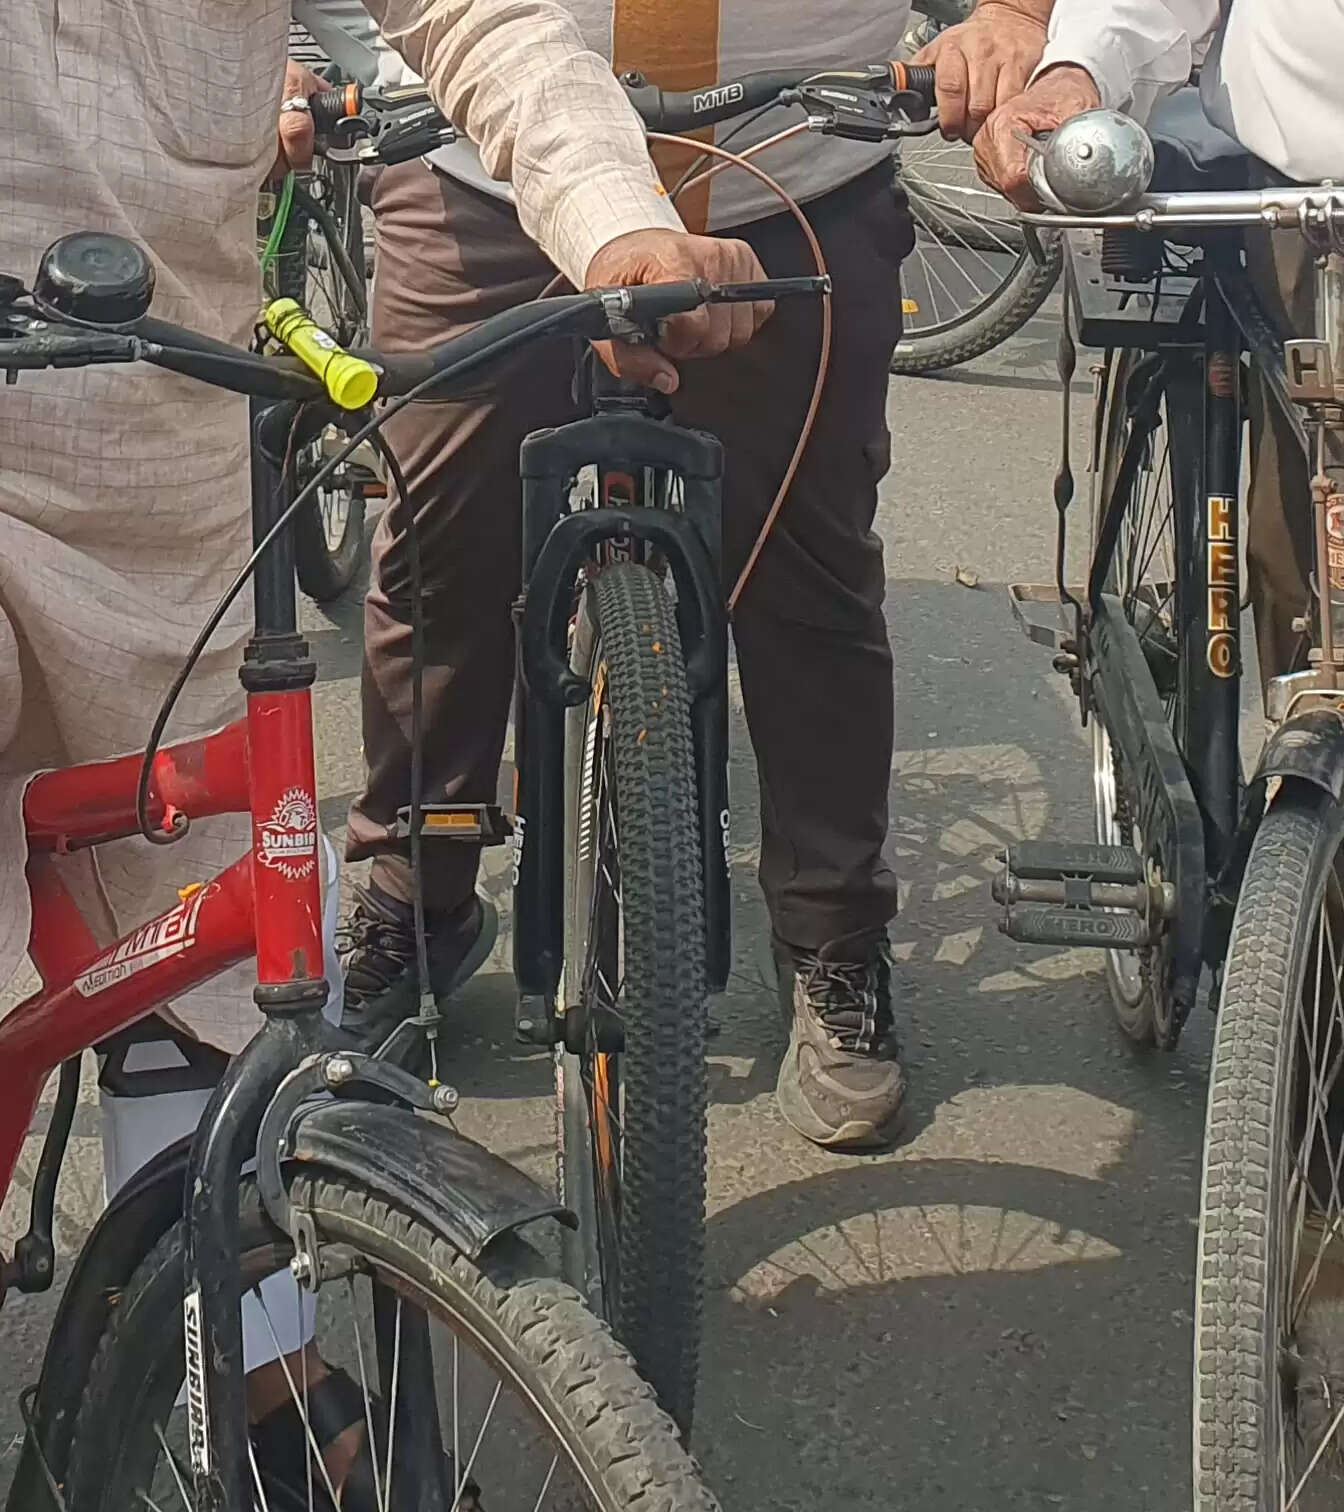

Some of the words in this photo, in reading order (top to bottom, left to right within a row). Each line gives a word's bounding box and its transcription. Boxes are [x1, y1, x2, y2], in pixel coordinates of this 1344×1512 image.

[693, 83, 743, 113] MTB
[1207, 495, 1238, 678] HERO
[262, 831, 316, 848] SUNBIR
[511, 815, 527, 887] HERO
